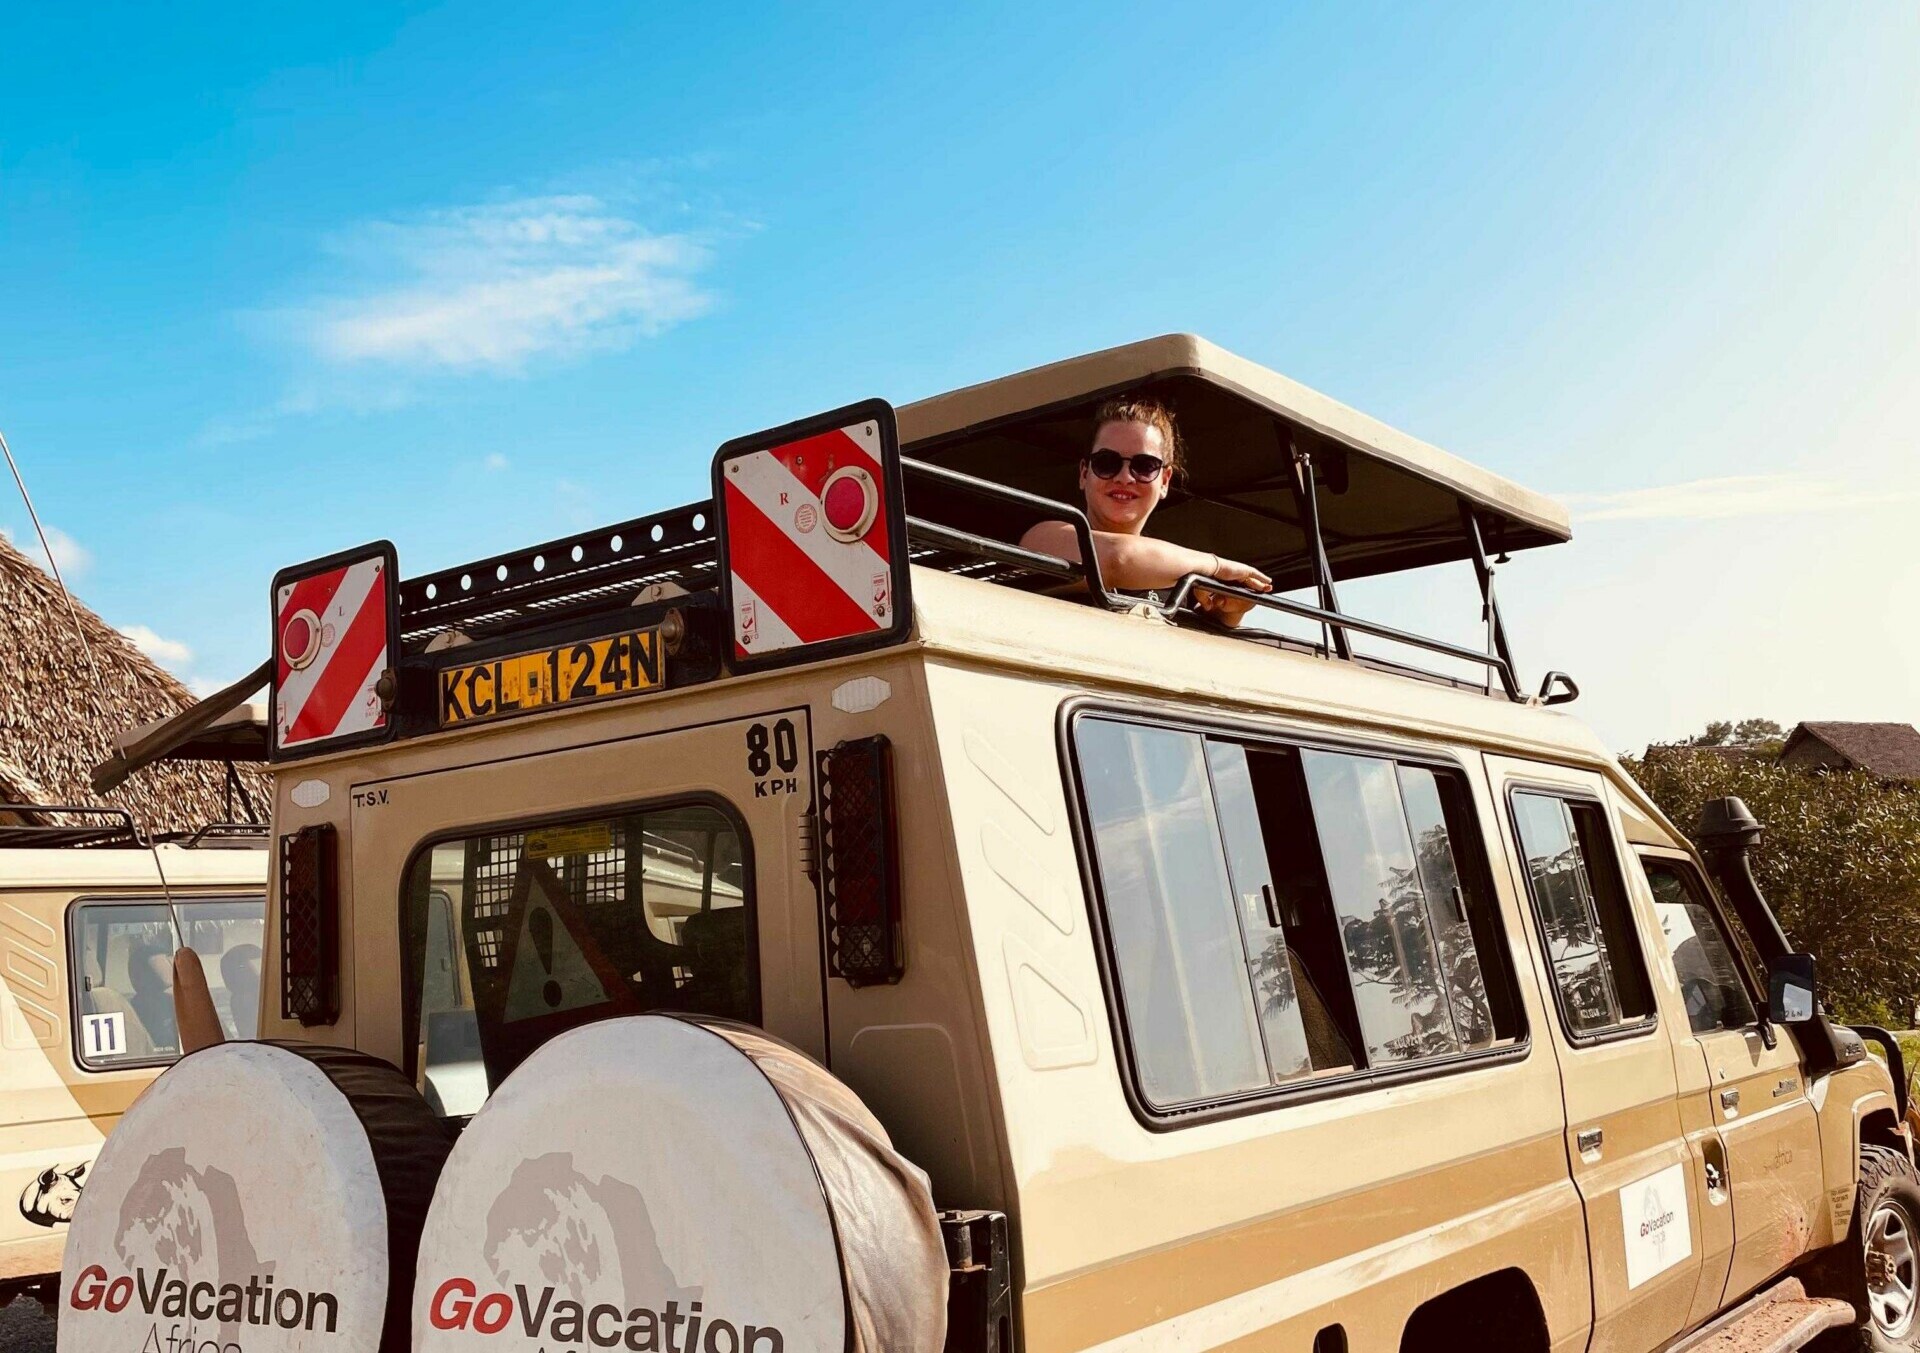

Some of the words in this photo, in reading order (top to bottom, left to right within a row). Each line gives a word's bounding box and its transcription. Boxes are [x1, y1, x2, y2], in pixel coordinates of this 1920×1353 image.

[780, 492, 789, 505] R
[442, 661, 520, 720] KCL
[546, 630, 659, 704] 124N
[746, 718, 798, 777] 80
[352, 789, 390, 808] T.S.V.
[754, 778, 797, 798] KPH
[90, 1017, 116, 1052] 11
[69, 1264, 339, 1333] GoVacation
[429, 1277, 785, 1353] GoVacation
[142, 1322, 242, 1353] Afri
